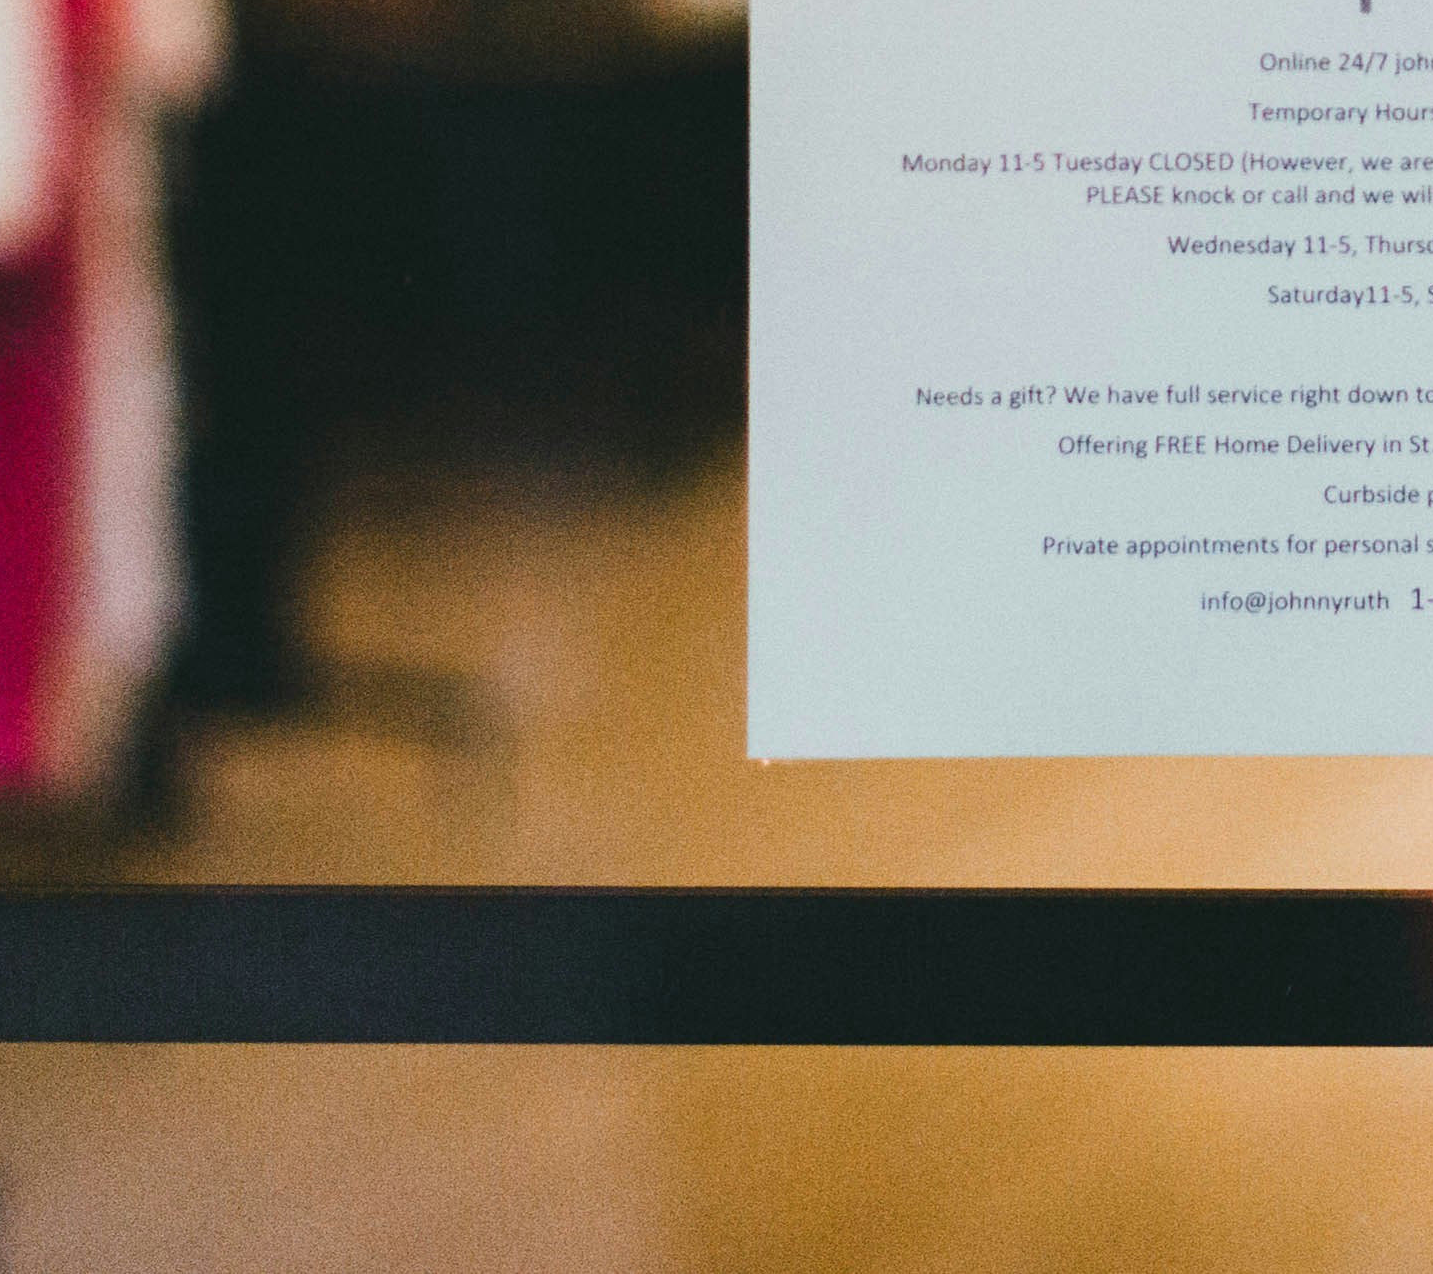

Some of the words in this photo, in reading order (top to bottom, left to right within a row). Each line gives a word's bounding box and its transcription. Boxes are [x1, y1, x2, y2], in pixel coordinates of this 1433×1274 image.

[1258, 51, 1332, 73] Online
[1338, 51, 1389, 75] 24/7
[1249, 102, 1369, 127] Temporary
[901, 153, 992, 177] Monday
[999, 152, 1046, 173] 11-5
[1053, 152, 1143, 176] Tuesday
[1148, 151, 1235, 173] CLOSED
[1241, 152, 1354, 175] (However,
[1361, 156, 1394, 172] we
[1085, 184, 1164, 206] PLEASE
[1171, 185, 1236, 206] knock
[1241, 189, 1266, 206] or
[1271, 184, 1309, 206] call
[1314, 184, 1356, 206] and
[1362, 189, 1396, 206] we
[1167, 235, 1297, 259] Wednesday
[1304, 234, 1358, 258] 11-5,
[915, 386, 984, 408] Needs
[990, 390, 1003, 407] a
[1008, 384, 1058, 411] gift?
[1063, 385, 1101, 406] We
[1107, 385, 1160, 406] have
[1165, 384, 1201, 406] full
[1206, 388, 1284, 406] service
[1289, 384, 1341, 410] right
[1347, 384, 1409, 405] down
[1057, 434, 1149, 460] Offering
[1154, 434, 1206, 455] FREE
[1214, 435, 1281, 456] Home
[1286, 434, 1377, 459] Delivery
[1382, 434, 1403, 454] in
[1322, 484, 1421, 505] Curbside
[1042, 535, 1120, 556] Private
[1125, 536, 1280, 560] appointments
[1285, 533, 1317, 555] for
[1323, 534, 1420, 559] personal
[1200, 590, 1391, 616] info@johnnyruth
